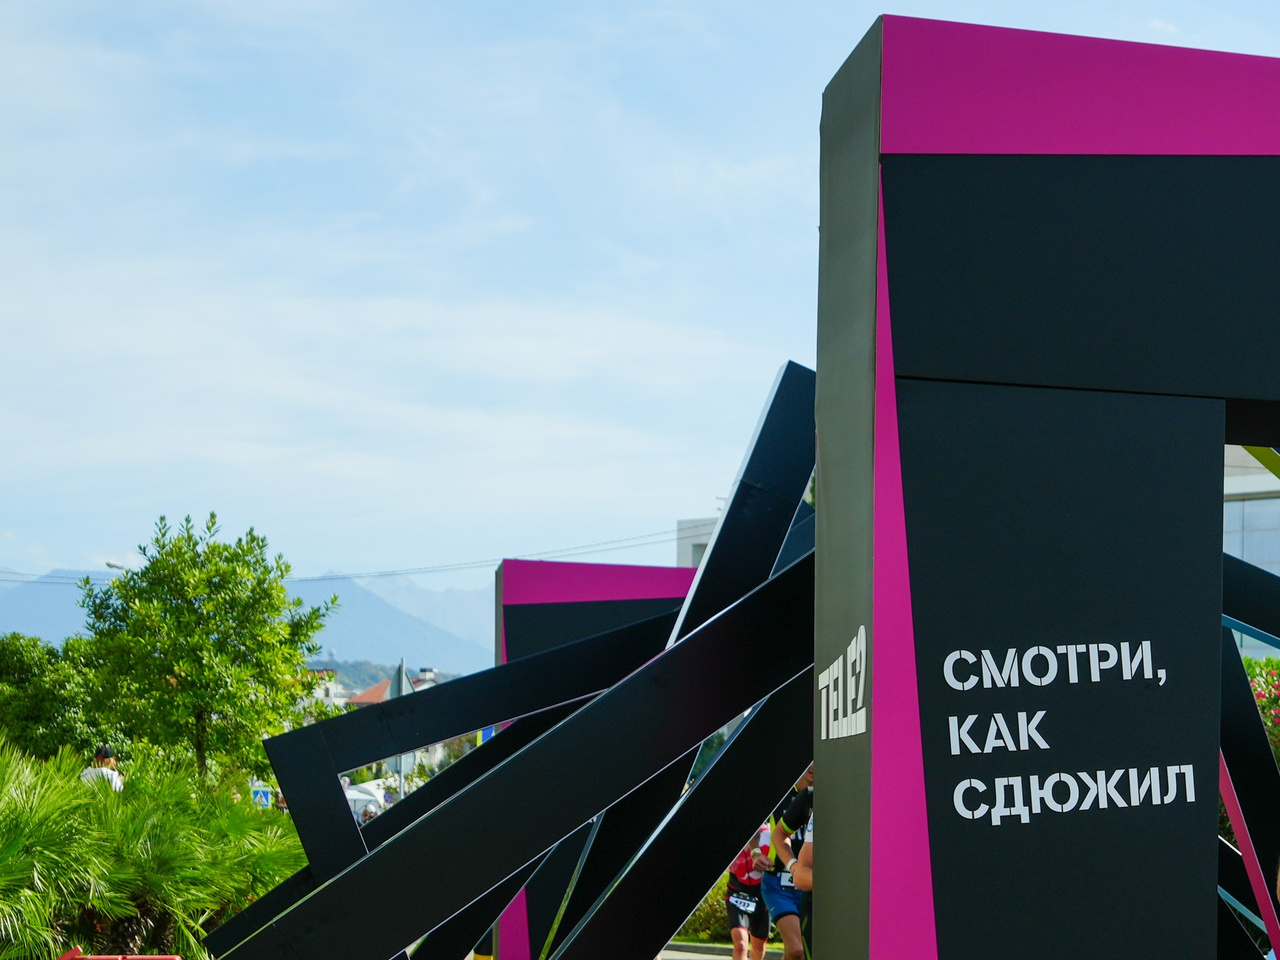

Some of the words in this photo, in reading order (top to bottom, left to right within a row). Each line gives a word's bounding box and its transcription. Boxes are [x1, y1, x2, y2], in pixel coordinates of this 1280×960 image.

[818, 624, 866, 740] TELE2
[943, 640, 1167, 691] СМОТРИ,
[948, 710, 1050, 755] КАК
[953, 764, 1196, 826] СДЮЖИЛ
